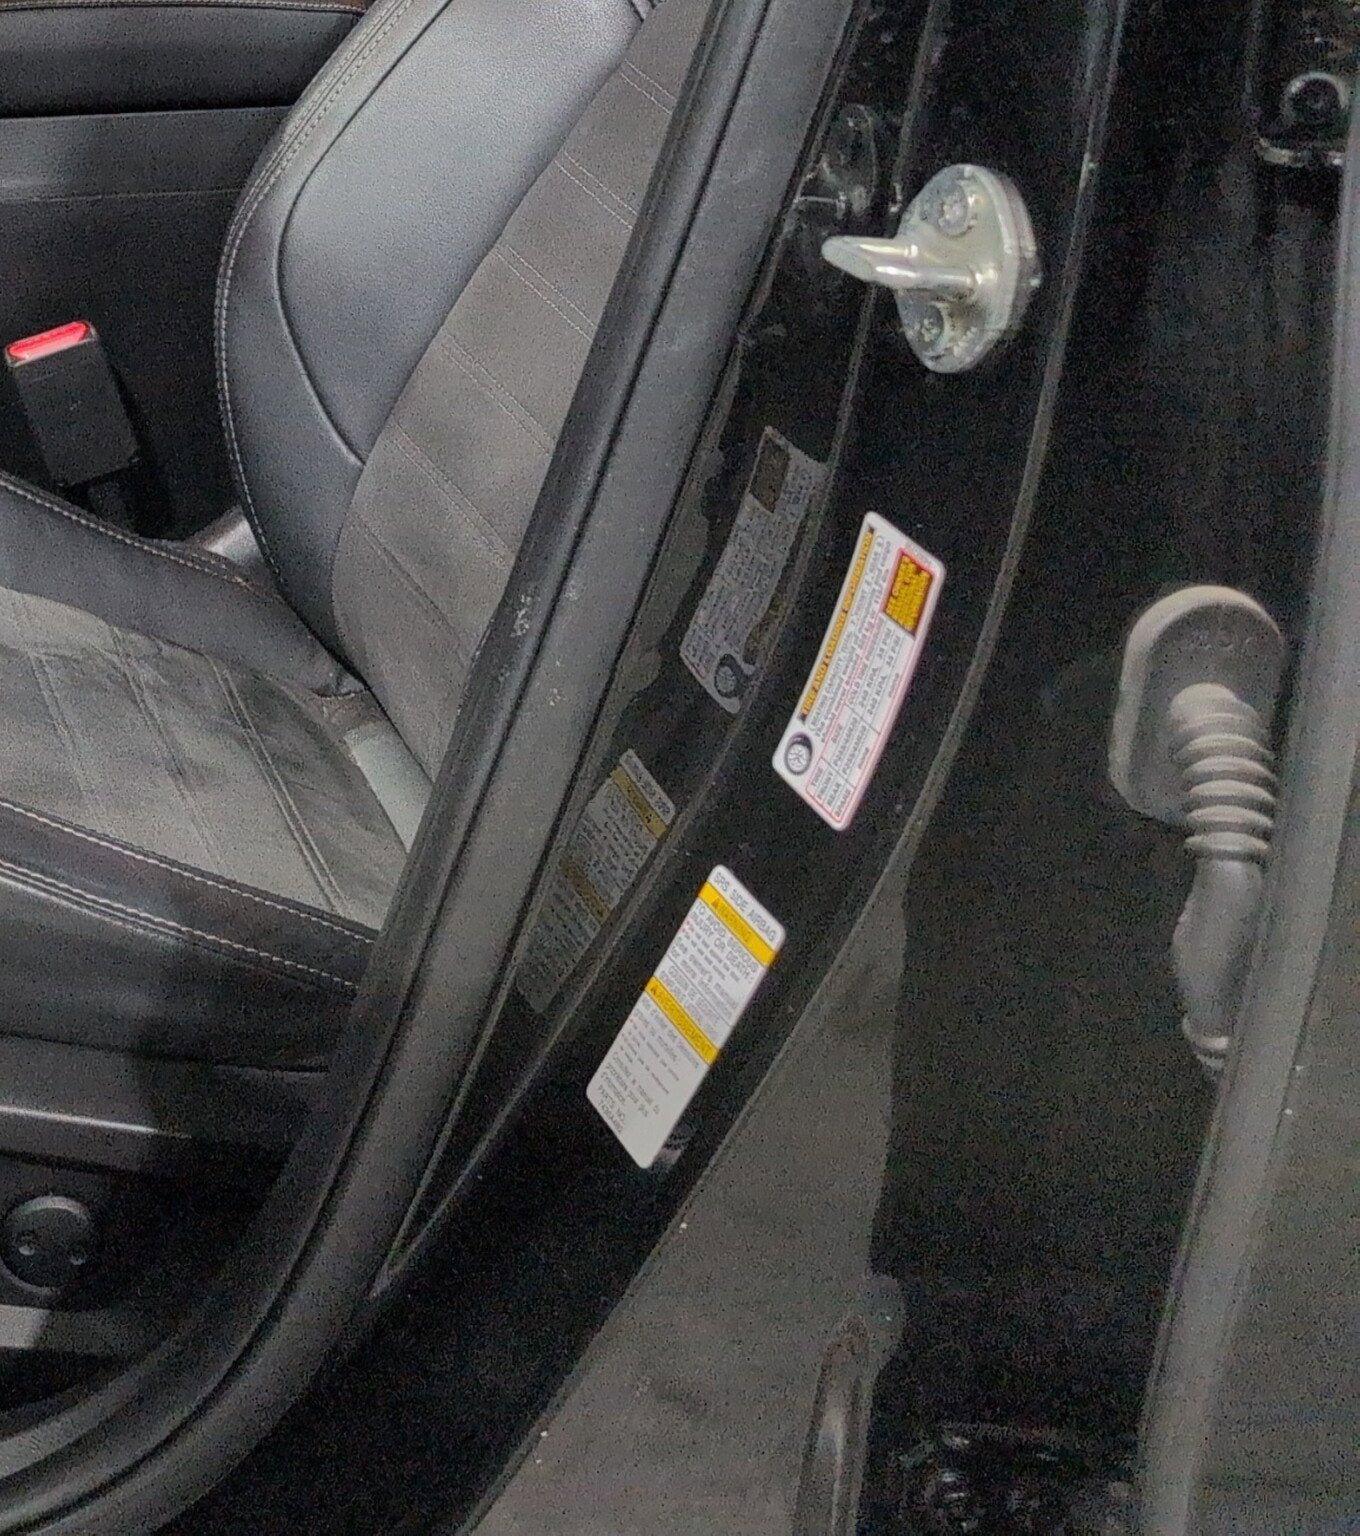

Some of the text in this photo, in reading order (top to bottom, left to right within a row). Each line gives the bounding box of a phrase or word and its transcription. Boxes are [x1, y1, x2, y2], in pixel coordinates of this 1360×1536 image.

[810, 660, 827, 692] AND
[821, 609, 847, 665] LOADING
[840, 530, 873, 613] INFORMATION
[816, 768, 834, 801] FRONT
[826, 779, 841, 807] REAR
[712, 870, 778, 943] SRS SIDE AIRBAG
[716, 900, 752, 943] WARNING
[688, 909, 714, 940] INJURY
[712, 935, 727, 954] OR
[694, 900, 760, 974] TO AVOID SERIOUS
